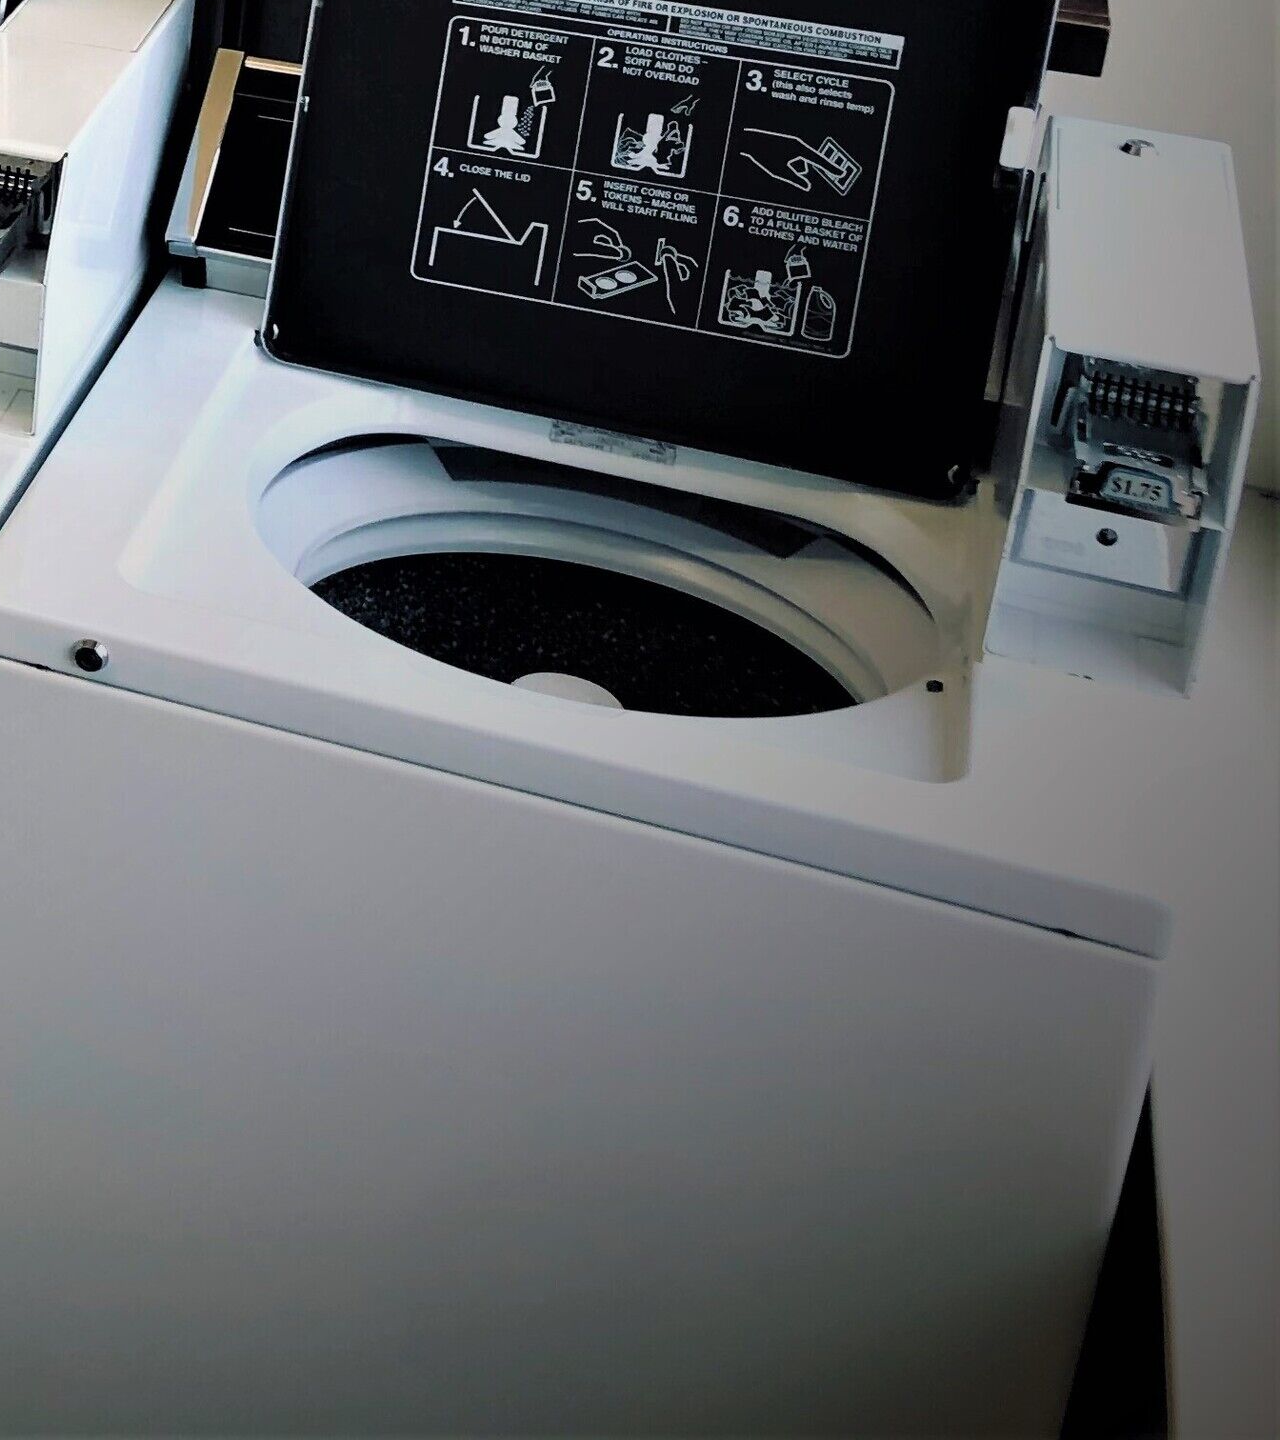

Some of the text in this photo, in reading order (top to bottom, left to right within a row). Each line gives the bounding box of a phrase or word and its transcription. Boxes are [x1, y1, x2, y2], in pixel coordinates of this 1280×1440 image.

[632, 0, 653, 11] FIRE
[655, 3, 669, 13] OR
[670, 5, 724, 21] EXPLOSION
[726, 14, 741, 23] OR
[742, 16, 813, 34] SPONTANEOUS
[815, 27, 882, 44] COMBUSTION
[459, 25, 476, 47] 1.
[479, 34, 549, 51] IN BOTTOM OF
[481, 24, 569, 45] POUR DETERGENT
[607, 28, 728, 54] OPERATING INSTRUCTIONS
[479, 44, 562, 64] WASHER BASKET
[597, 46, 619, 69] 2.
[625, 46, 654, 58] LOAD
[622, 66, 700, 86] NOT OVERLOAD
[624, 56, 695, 74] SORT AND DO
[745, 69, 768, 93] 3.
[774, 69, 850, 89] SELECT CYCLE
[771, 91, 797, 101] wash
[798, 95, 818, 105] and
[433, 156, 455, 178] 4.
[459, 163, 531, 183] CLOSE THE LID
[576, 179, 597, 203] 5.
[603, 180, 689, 203] INSERT COINS OR
[603, 190, 696, 214] TOKENS MACHINE
[601, 200, 698, 225] WILL START FILLING
[723, 205, 745, 228] 6.
[751, 206, 864, 233] ADD DILUTED BLEACH
[748, 226, 858, 252] CLOTHES AND WATER
[750, 215, 864, 242] TO A FULL BASKET OF
[1111, 477, 1163, 502] $1.75
